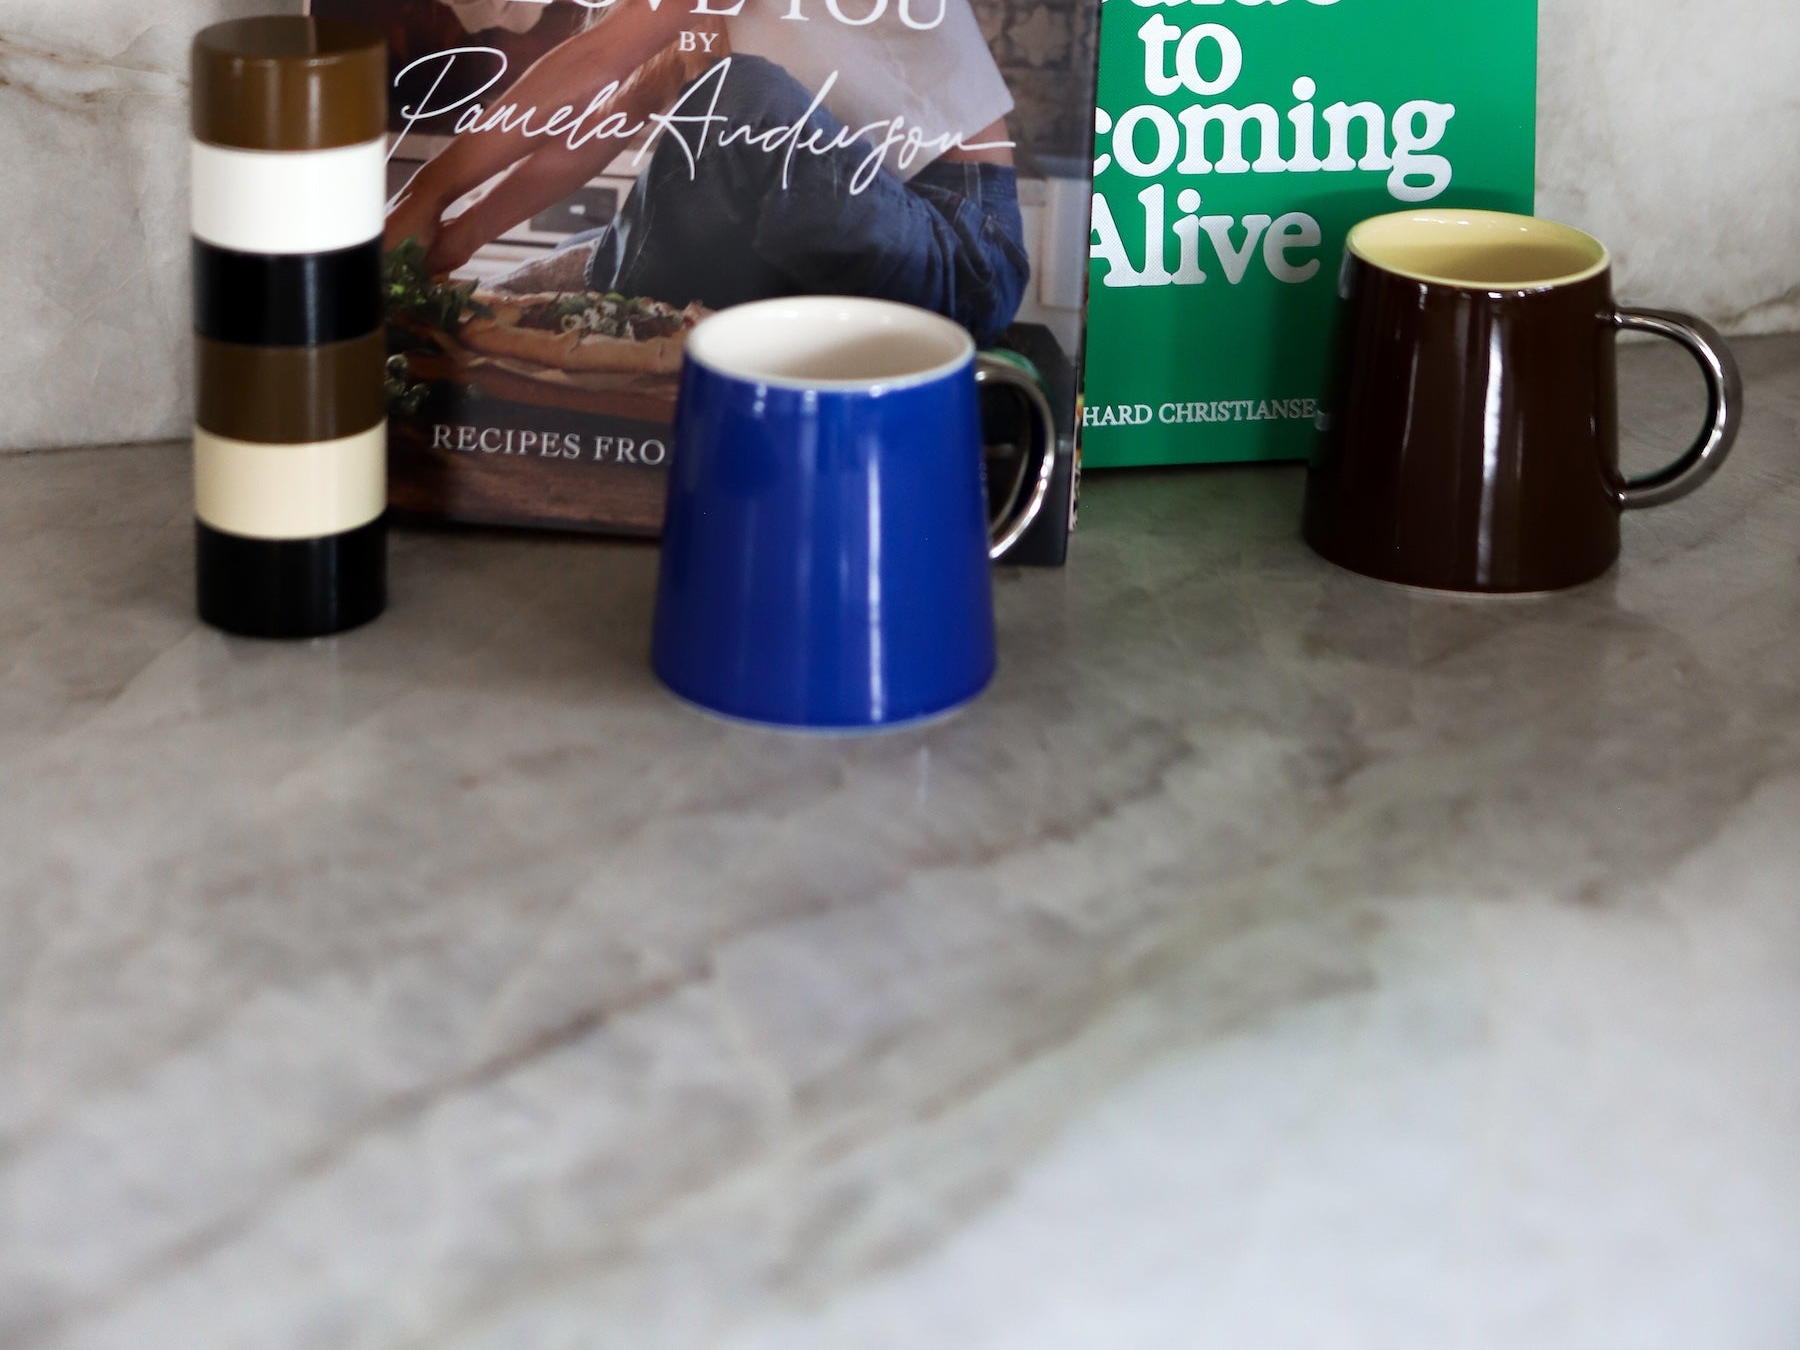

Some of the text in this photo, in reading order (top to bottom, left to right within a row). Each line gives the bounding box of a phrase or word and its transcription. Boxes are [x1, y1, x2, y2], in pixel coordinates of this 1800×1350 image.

[678, 30, 719, 53] BY
[1137, 13, 1242, 96] to
[384, 46, 1017, 196] Pamela Anderson
[1157, 399, 1319, 423] CHRISTIANSE
[432, 423, 673, 466] RECIPES FRO
